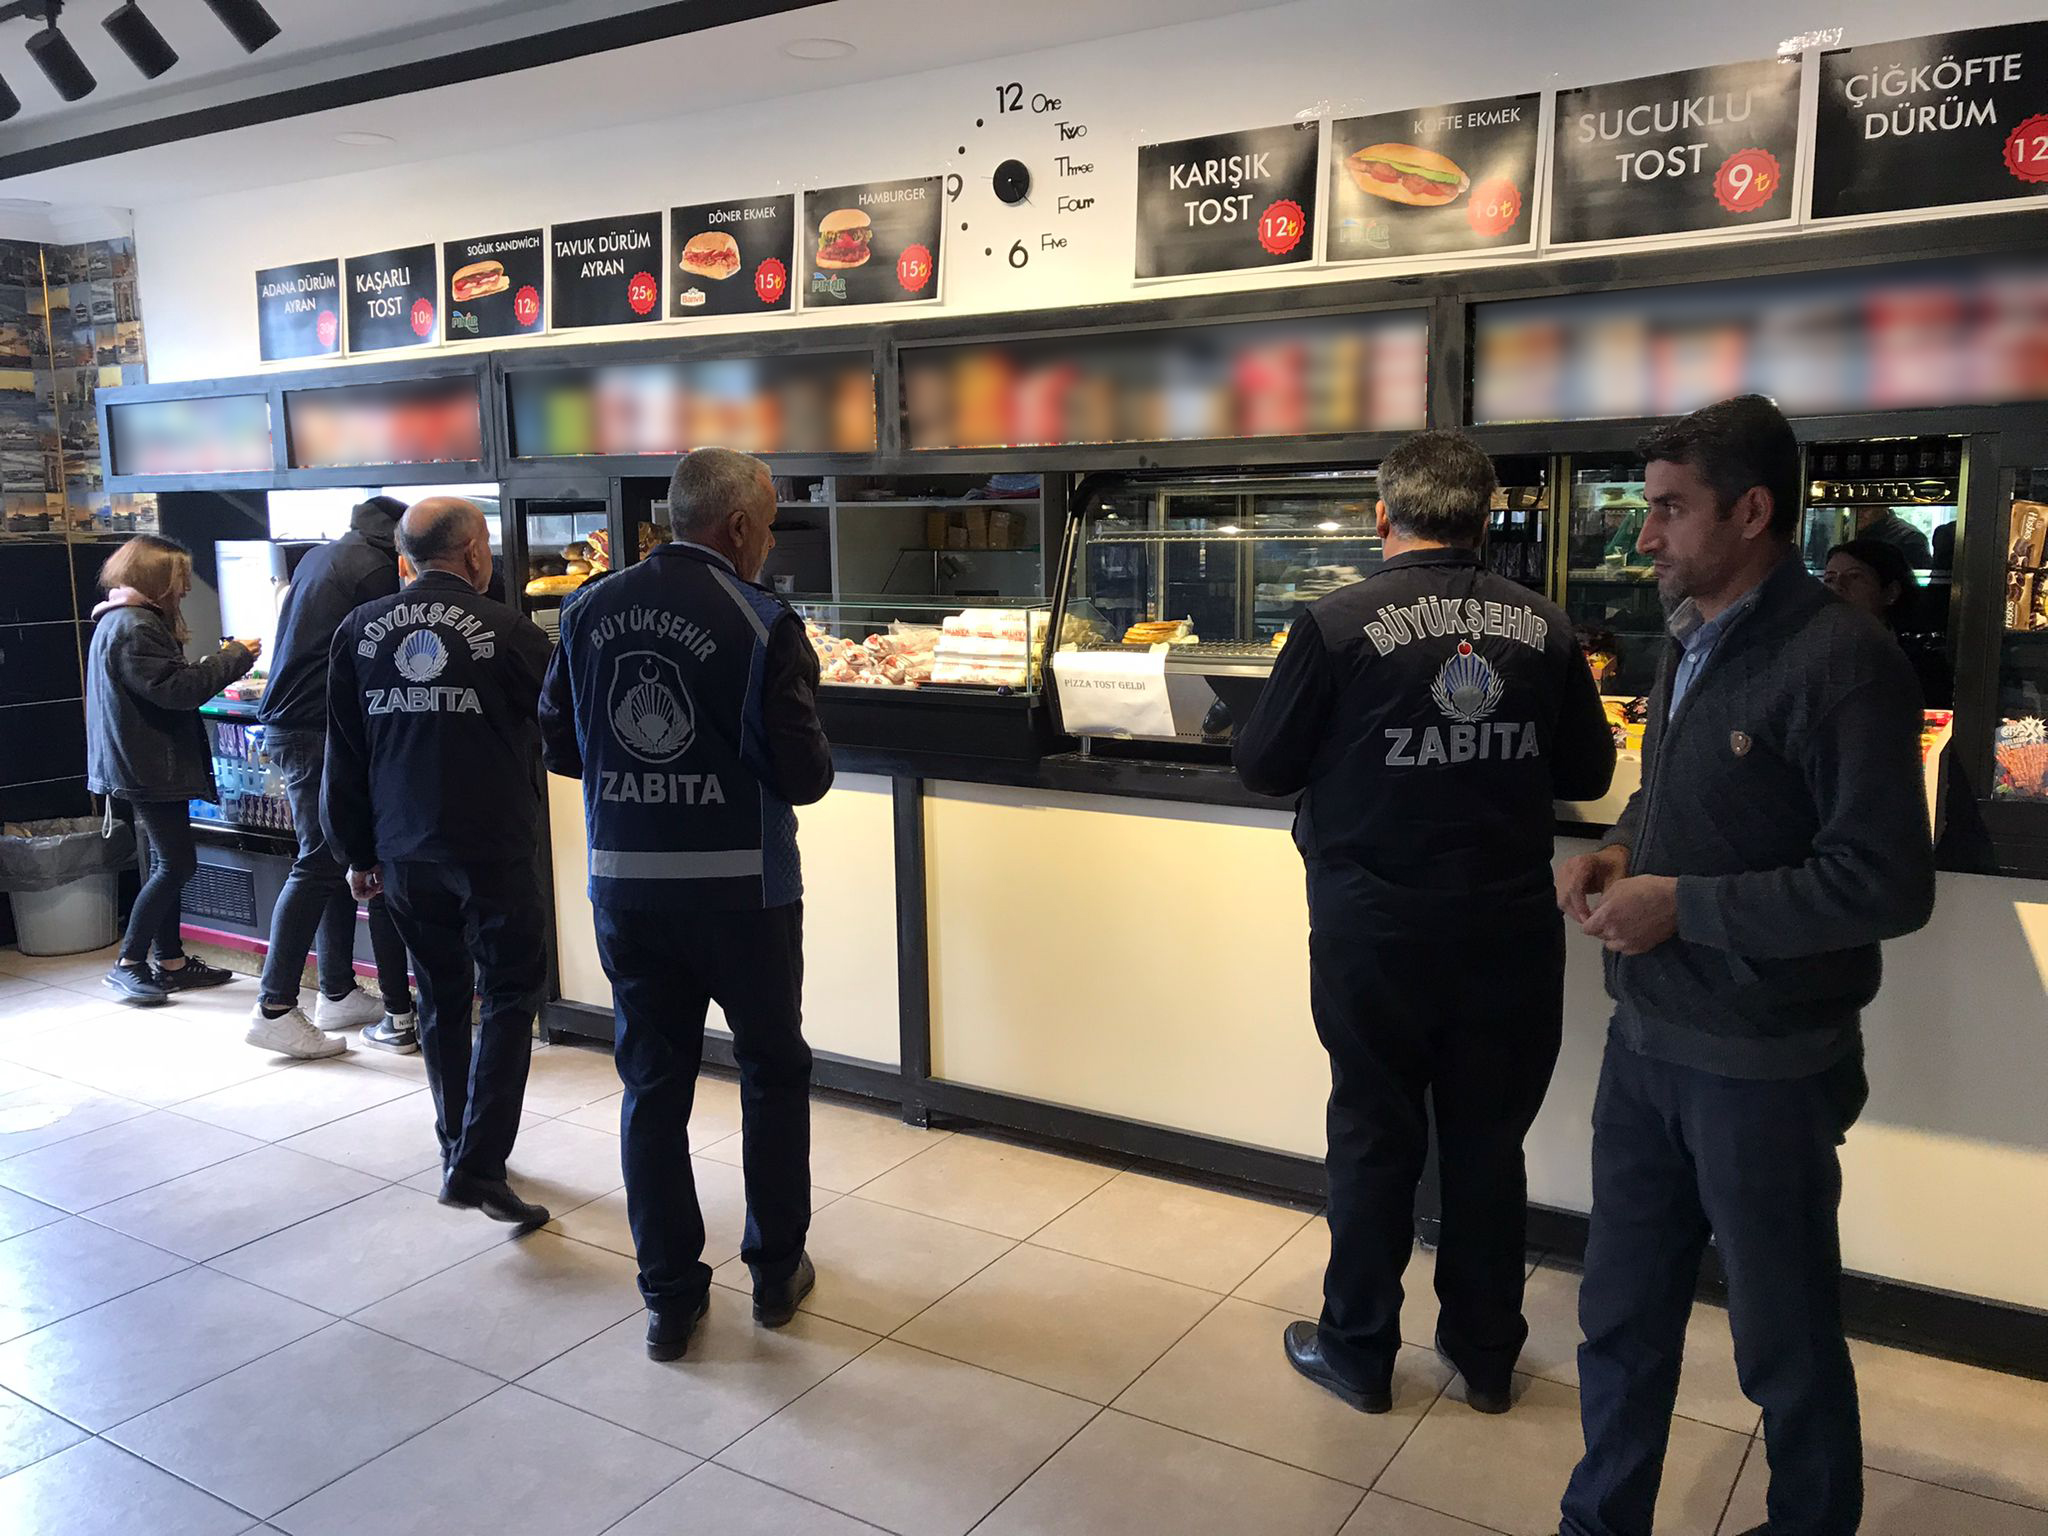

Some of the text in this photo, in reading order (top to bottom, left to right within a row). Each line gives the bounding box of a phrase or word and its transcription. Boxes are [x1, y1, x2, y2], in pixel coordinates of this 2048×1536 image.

[1845, 53, 2023, 108] ÇİĞKÖFTE
[996, 82, 1062, 114] 12 One
[1054, 121, 1088, 141] Two
[1467, 107, 1522, 128] EKMEK
[1577, 90, 1753, 144] SUCUKLU
[1864, 98, 1998, 141] DÜRÜM
[1054, 156, 1094, 177] Three
[1169, 151, 1271, 191] KARIŞIK
[1615, 143, 1709, 183] TOST
[858, 187, 926, 206] HAMBURGER
[946, 173, 964, 203] 9
[708, 206, 777, 225] DÖNER EKMEK
[1058, 195, 1095, 214] Four
[1184, 194, 1254, 227] TOST
[467, 242, 494, 257] SOĞUK
[555, 229, 651, 258] TAVUK DÜRÜM
[1008, 239, 1029, 269] 6
[1041, 233, 1068, 251] Five
[356, 266, 411, 294] KAŞARLI
[580, 258, 625, 279] AYRAN
[262, 272, 336, 298] ADANA DÜRÜM
[284, 298, 316, 315] AYRAN
[367, 296, 403, 319] TOST
[357, 601, 496, 661] BÜYÜKŞEHİR
[590, 604, 718, 663] BÜYÜKŞEHİR
[1363, 595, 1549, 658] BÜYÜKŞEHİR
[1095, 679, 1116, 690] TOST
[365, 686, 484, 716] ZABITA
[1384, 721, 1541, 767] ZABITA
[601, 770, 726, 805] ZABITA
